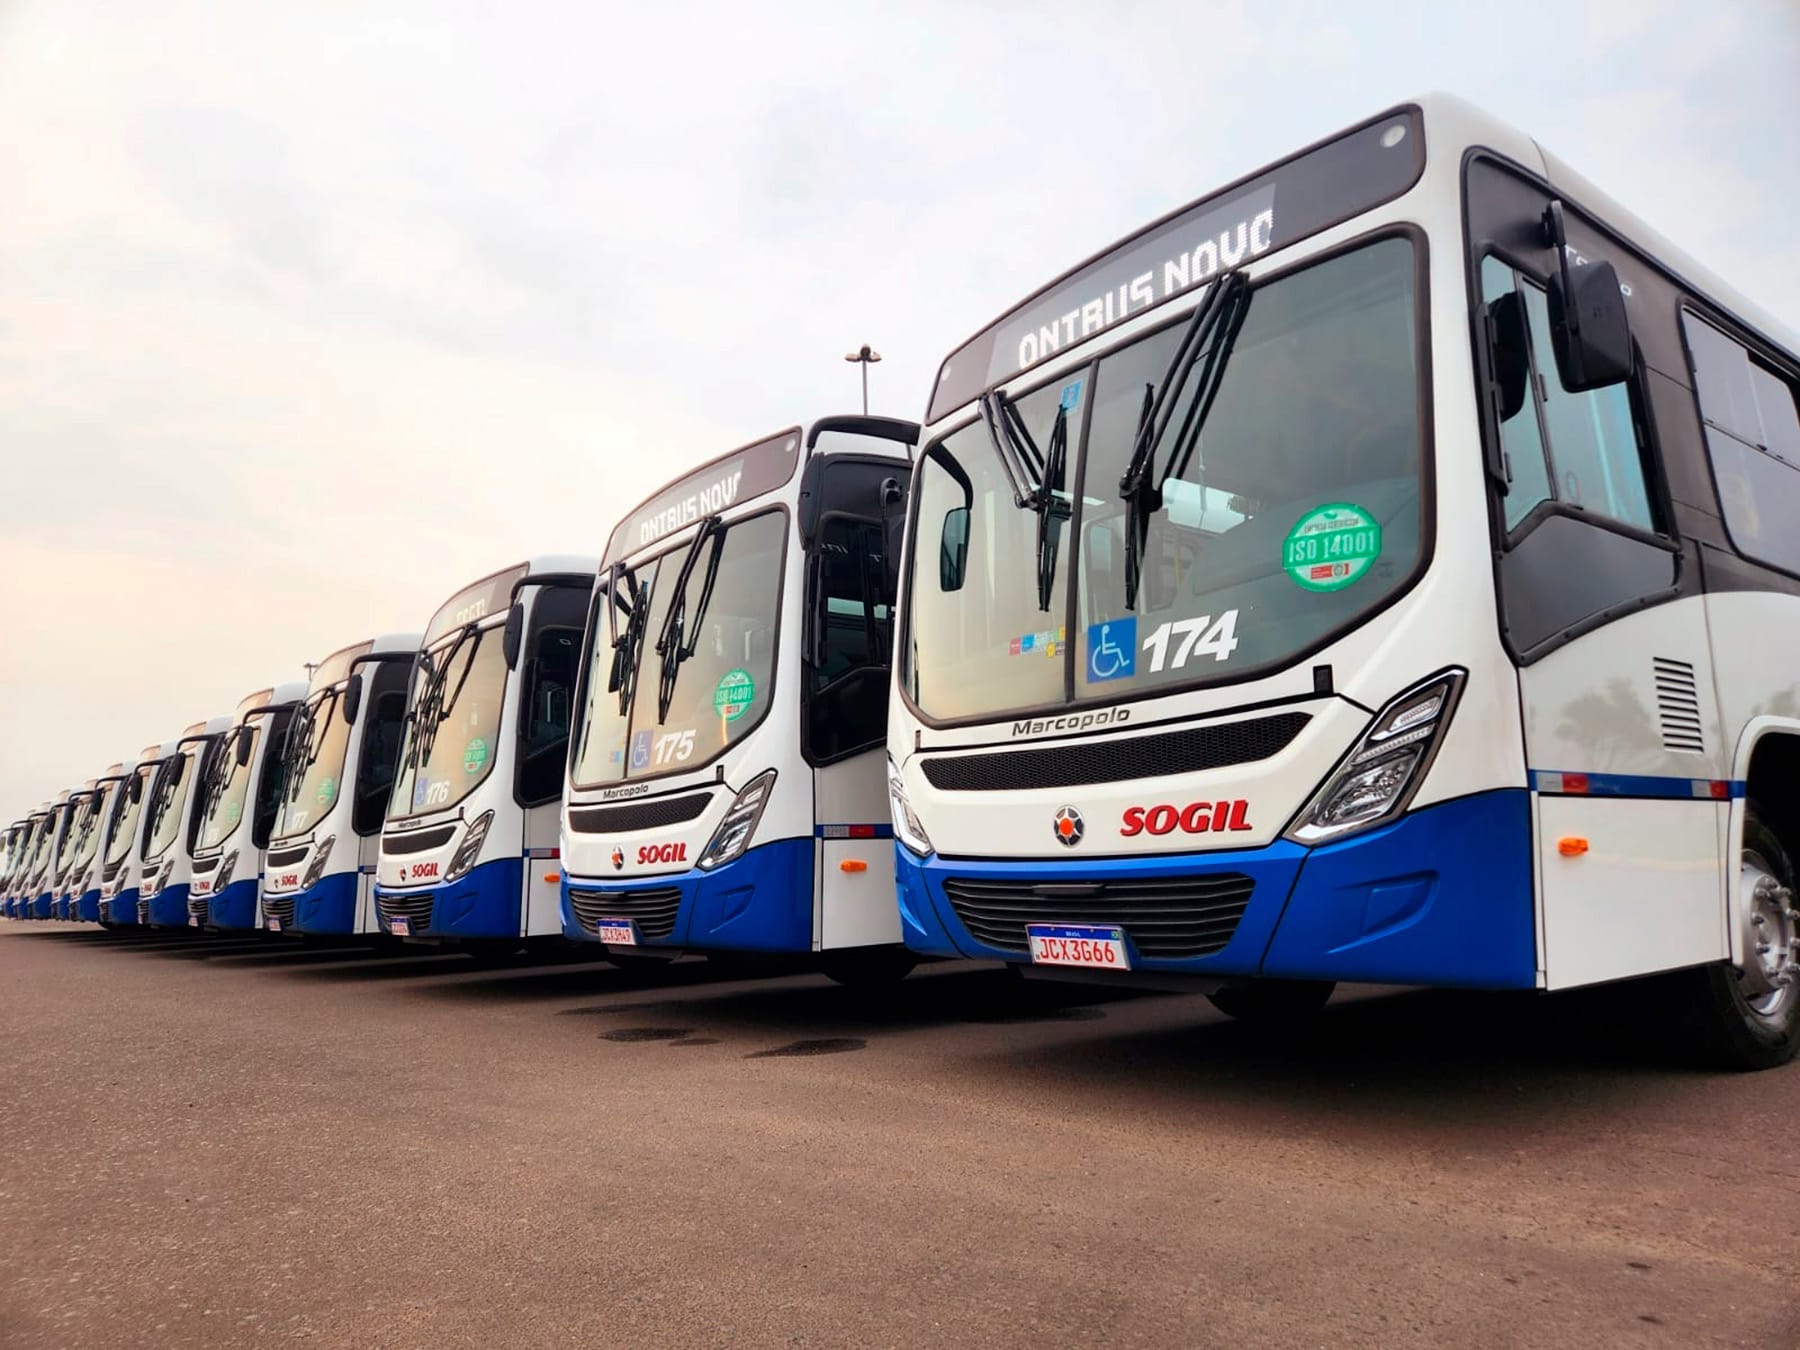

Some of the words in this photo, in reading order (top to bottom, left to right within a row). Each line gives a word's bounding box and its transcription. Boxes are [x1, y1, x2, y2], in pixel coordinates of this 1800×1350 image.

[1289, 540, 1317, 563] ISO
[1323, 530, 1375, 559] 14001
[1142, 609, 1240, 673] 174
[1012, 707, 1131, 736] Marcopolo
[655, 729, 697, 765] 175
[425, 781, 449, 804] 176
[603, 784, 649, 800] Marcopolo
[1120, 799, 1253, 837] SOGIL
[637, 842, 688, 865] SOGIL
[411, 862, 439, 878] SOGIL
[1039, 938, 1115, 964] JCX3G66
